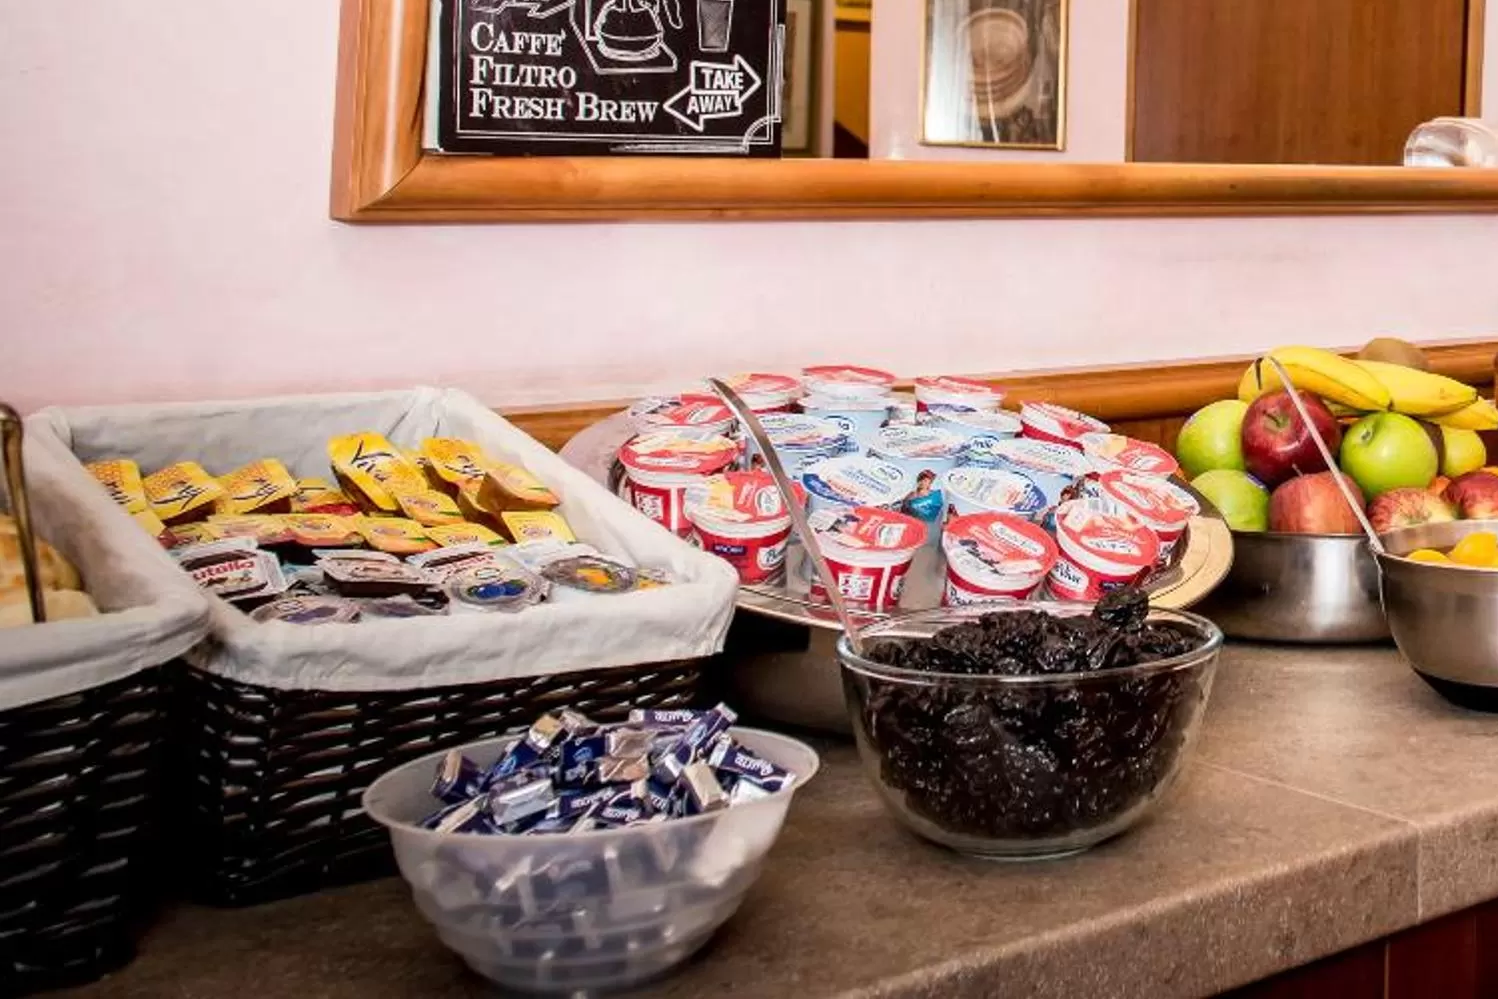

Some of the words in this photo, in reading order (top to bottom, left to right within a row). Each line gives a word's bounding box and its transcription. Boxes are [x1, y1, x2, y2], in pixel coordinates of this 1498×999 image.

[469, 54, 577, 89] FILTRO
[700, 67, 744, 90] TAKE
[469, 87, 566, 121] FRESH
[574, 91, 660, 122] BREW
[686, 95, 732, 115] AWAY
[186, 559, 256, 582] utella
